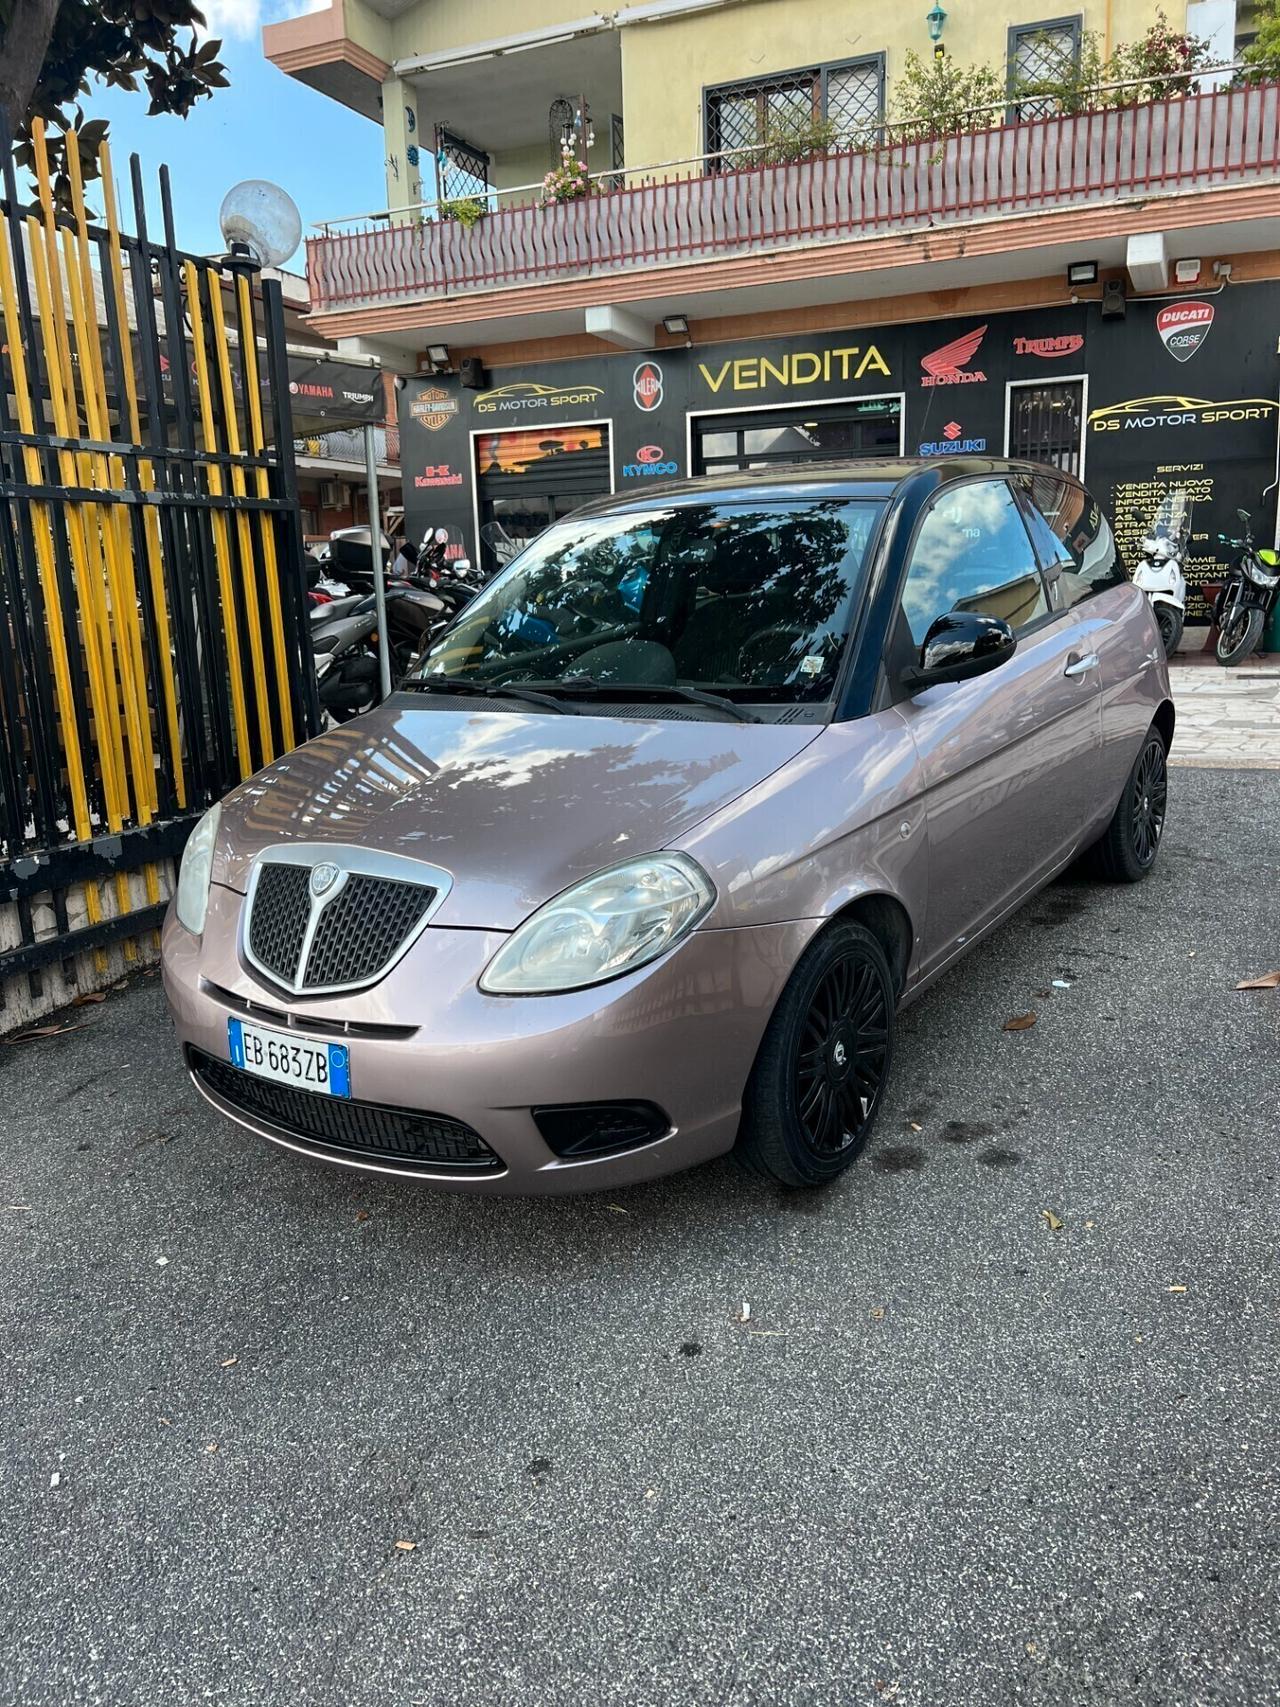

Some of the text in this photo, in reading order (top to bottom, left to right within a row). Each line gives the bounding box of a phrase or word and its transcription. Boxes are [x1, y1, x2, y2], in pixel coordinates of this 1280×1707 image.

[1161, 309, 1210, 323] DUCATI
[1169, 334, 1201, 347] CORSE
[698, 345, 892, 393] VENDITA
[920, 371, 987, 387] HONDA
[298, 383, 334, 398] YAMAHA
[342, 391, 374, 403] TRIUMPH
[478, 393, 598, 413] DS MOTOR SPORT
[1093, 407, 1273, 432] DS MOTOR SPORT
[919, 438, 987, 456] SUZUKI
[622, 461, 678, 477] KYMCO
[1156, 463, 1204, 473] SERVIZI
[1116, 478, 1214, 490] VENDITA NUOVO
[1116, 486, 1211, 498] VENDITA USATO
[1115, 494, 1213, 506] INFORTUNISTICA
[243, 1032, 328, 1083] EB 683ZB
